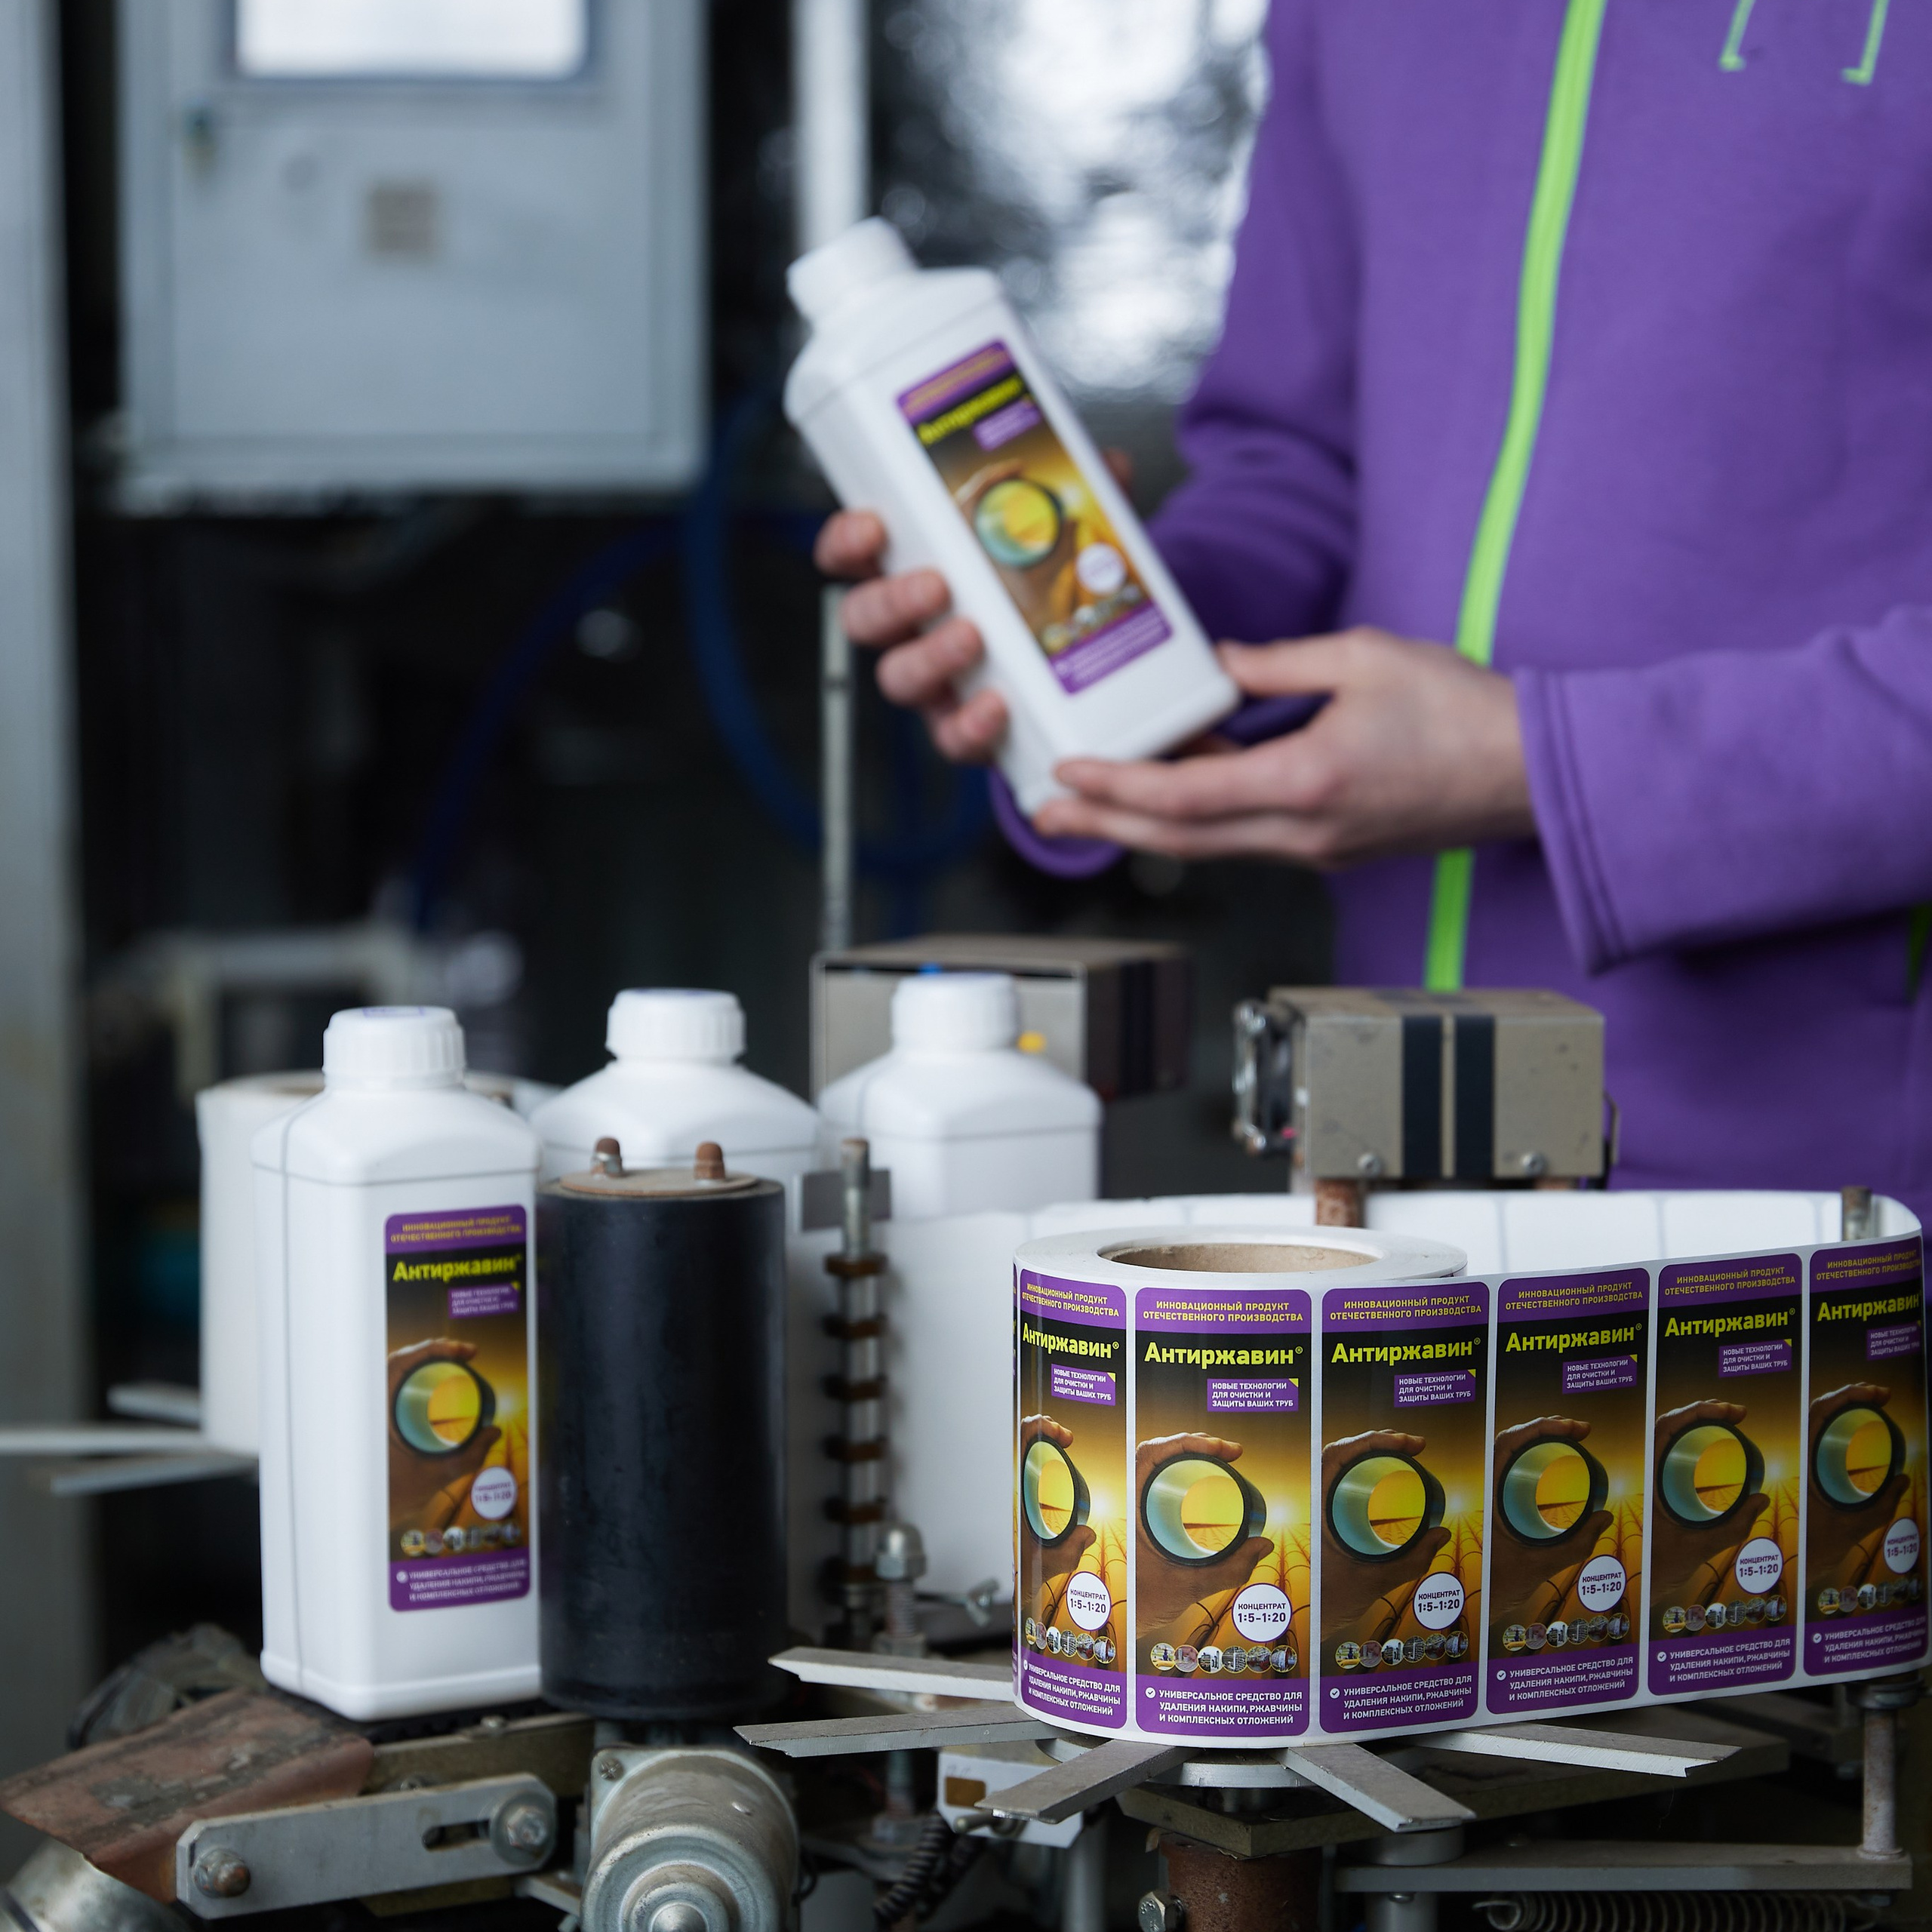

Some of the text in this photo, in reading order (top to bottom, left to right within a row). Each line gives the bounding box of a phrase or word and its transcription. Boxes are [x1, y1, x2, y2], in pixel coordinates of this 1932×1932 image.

[1828, 1254, 1892, 1269] ИННОВАЦИОННЫЙ
[1677, 1266, 1784, 1284] ИННОВАЦИОННЫЙ ПРОДУКТ
[1817, 1266, 1880, 1280] ОТЕЧЕСТВЕННОГО
[1518, 1281, 1632, 1299] ИННОВАЦИОННЫЙ ПРОДУКТ
[1665, 1275, 1795, 1296] ОТЕЧЕСТВЕННОГО ПРОИЗВОДСТВА
[1075, 1293, 1107, 1305] ПРОДУКТ
[1344, 1295, 1469, 1309] ИННОВАЦИОННЫЙ ПРОДУКТ
[1505, 1291, 1642, 1310] ОТЕЧЕСТВЕННОГО ПРОИЗВОДСТВА
[1063, 1302, 1118, 1317] ПРОИЗВОДСТВА
[1156, 1301, 1289, 1312] ИННОВАЦИОННЫЙ ПРОДУКТ
[1330, 1305, 1481, 1320] ОТЕЧЕСТВЕННОГО ПРОИЗВОДСТВА
[1143, 1311, 1303, 1322] ОТЕЧЕСТВЕННОГО ПРОИЗВОДСТВА
[1723, 1343, 1782, 1356] НОВЫЕ ТЕХНОЛОГИИ
[1567, 1359, 1628, 1372] НОВЫЕ ТЕХНОЛОГИИ
[1722, 1357, 1736, 1365] ДЛЯ
[1737, 1354, 1764, 1363] ОЧИСТКИ
[1723, 1364, 1749, 1373] ЗАЩИТЫ
[1751, 1361, 1772, 1370] ВАШИХ
[1054, 1368, 1106, 1383] НОВЫЕ ТЕХНОЛОГИИ
[1424, 1374, 1466, 1383] ТЕХНОЛОГИИ
[1566, 1373, 1580, 1381] ДЛЯ
[1582, 1370, 1609, 1379] ОЧИСТКИ
[1054, 1377, 1063, 1385] ДЛЯ
[1065, 1379, 1088, 1389] ОЧИСТКИ
[1567, 1380, 1594, 1389] ЗАЩИТЫ
[1595, 1377, 1617, 1386] ВАШИХ
[1054, 1386, 1111, 1401] ЗАЩИТЫ ВАШИХ ТРУБ
[1398, 1386, 1414, 1395] ДЛЯ
[1415, 1384, 1445, 1392] ОЧИСТКИ
[1398, 1394, 1429, 1402] ЗАЩИТЫ
[1430, 1392, 1454, 1400] ВАШИХ
[1740, 1555, 1779, 1564] КОНЦЕНТРАТ
[1583, 1572, 1622, 1583] КОНЦЕНТРАТ
[1070, 1589, 1106, 1601] КОНЦЕНТРАТ
[1418, 1589, 1460, 1600] КОНЦЕНТРАТ
[1670, 1638, 1789, 1660] УНИВЕРСАЛЬНОЕ СРЕДСТВО ДЛЯ
[1509, 1657, 1632, 1678] УНИВЕРСАЛЬНОЕ СРЕДСТВО ДЛЯ
[1670, 1659, 1711, 1671] УДАЛЕНИЯ
[1678, 1668, 1734, 1681] КОМПЛЕКСНЫХ
[1737, 1660, 1782, 1675] ОТЛОЖЕНИЙ
[1069, 1677, 1103, 1690] СРЕДСТВО
[1104, 1683, 1120, 1694] ДЛЯ
[1343, 1675, 1472, 1697] УНИВЕРСАЛЬНОЕ СРЕДСТВО ДЛЯ
[1509, 1678, 1552, 1690] УДАЛЕНИЯ
[1509, 1678, 1625, 1701] И КОМПЛЕКСНЫХ ОТЛОЖЕНИЙ
[1028, 1686, 1112, 1715] И КОМПЛЕКСНЫХ ОТЛОЖЕНИЙ
[1159, 1690, 1302, 1702] УНИВЕРСАЛЬНОЕ СРЕДСТВО ДЛЯ
[1159, 1702, 1206, 1712] УДАЛЕНИЯ
[1343, 1697, 1388, 1708] УДАЛЕНИЯ
[1343, 1697, 1463, 1720] И КОМПЛЕКСНЫХ ОТЛОЖЕНИЙ
[1168, 1715, 1235, 1724] КОМПЛЕКСНЫХ
[1238, 1715, 1294, 1724] ОТЛОЖЕНИЙ
